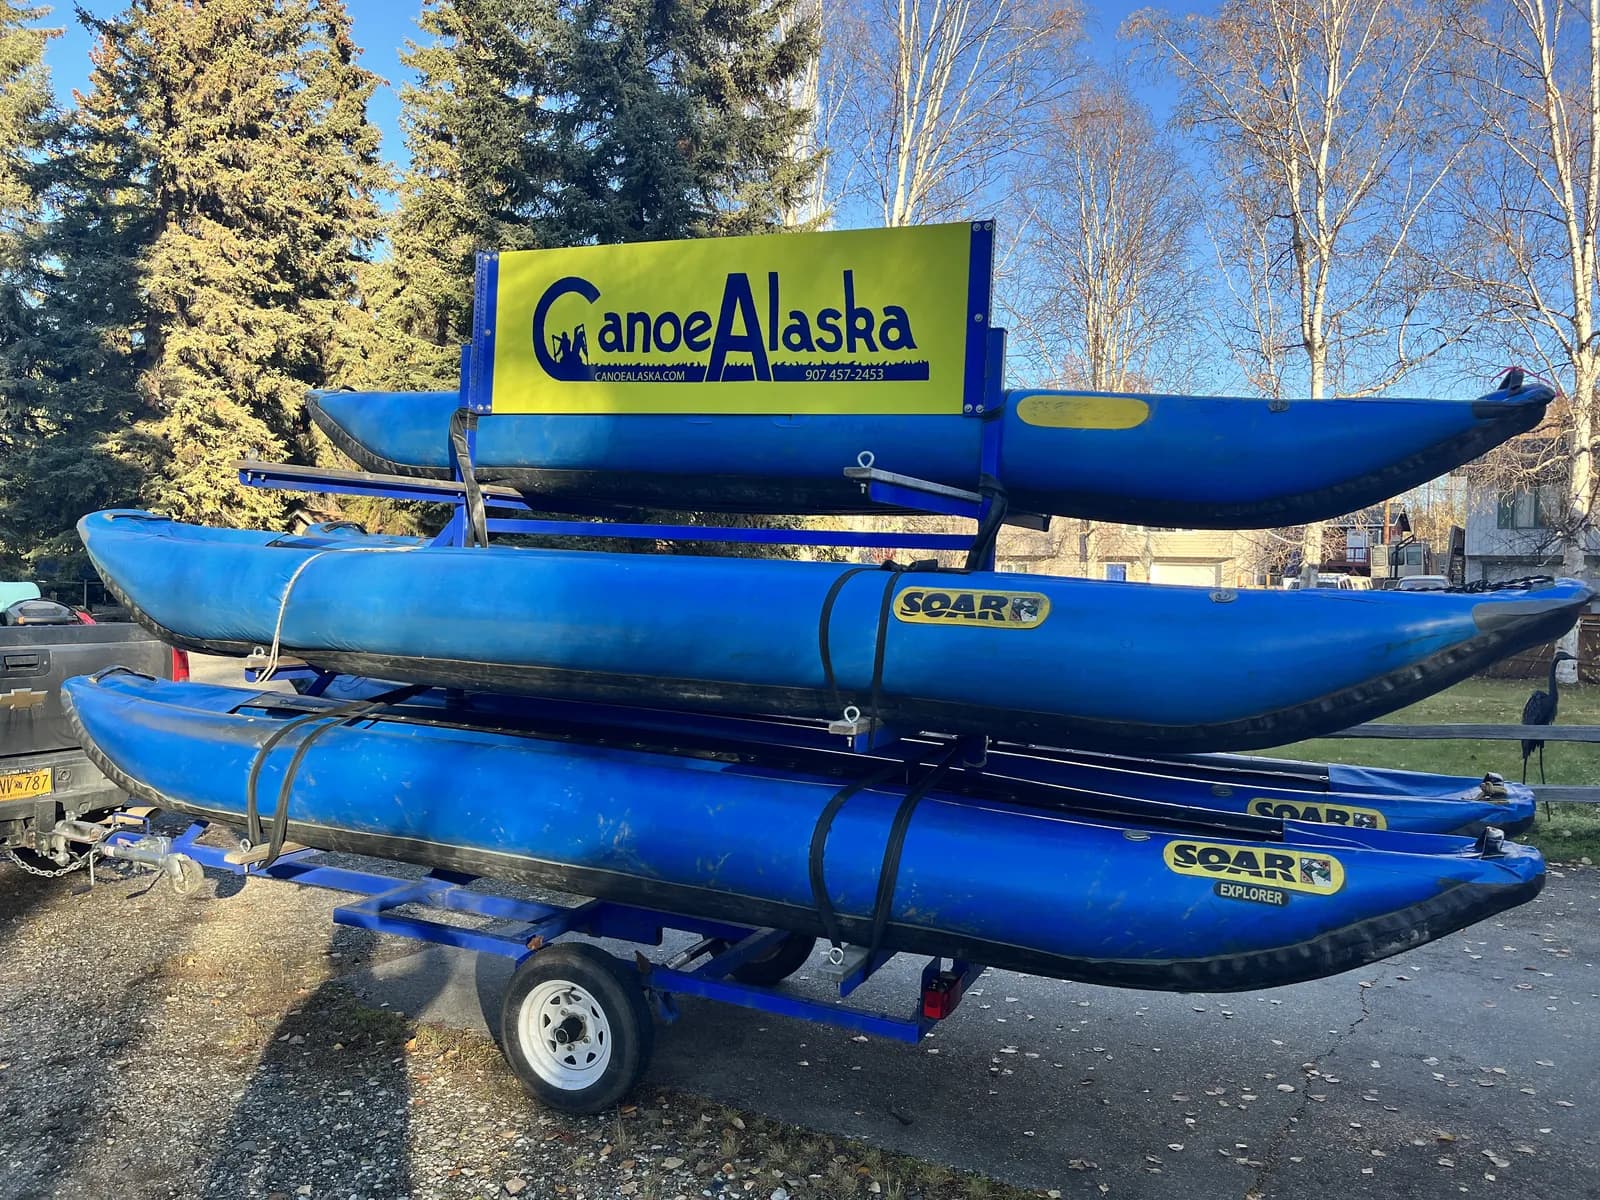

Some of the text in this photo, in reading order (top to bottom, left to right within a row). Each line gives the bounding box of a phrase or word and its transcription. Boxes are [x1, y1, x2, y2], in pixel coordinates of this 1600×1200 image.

[594, 371, 686, 382] CANOEALASKA.COM
[805, 368, 885, 381] 907 457-2453
[900, 592, 1009, 621] SOAR
[25, 774, 49, 792] 787
[1255, 802, 1350, 825] SOAR
[1173, 844, 1297, 882] SOAR
[1220, 883, 1283, 905] EXPLORER
